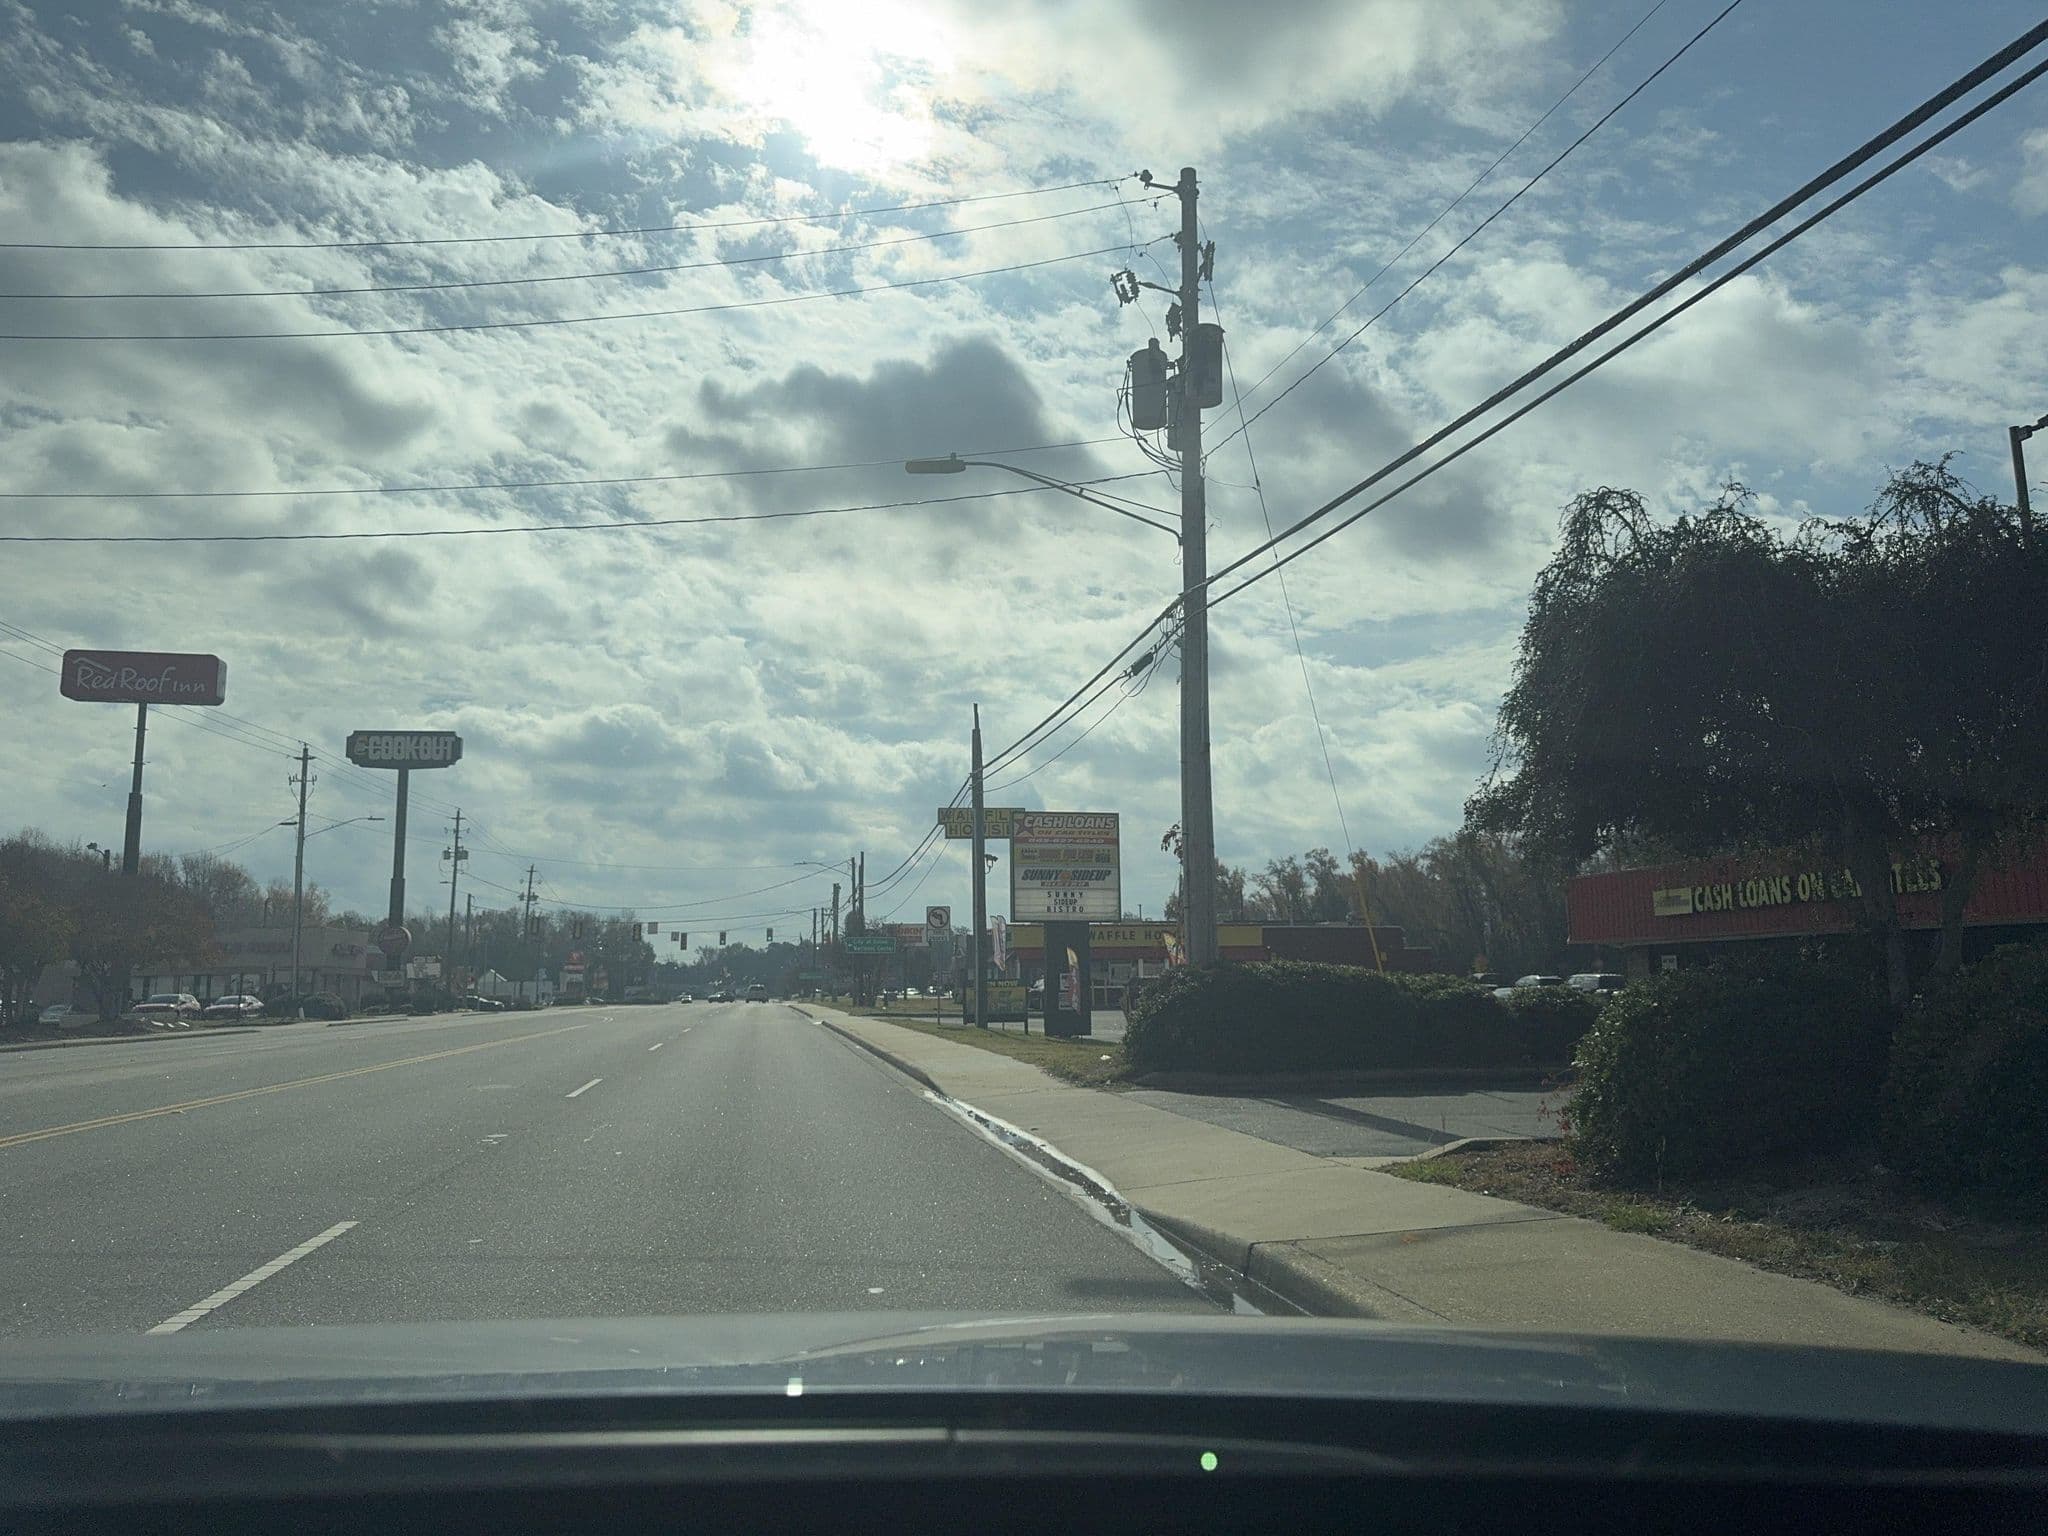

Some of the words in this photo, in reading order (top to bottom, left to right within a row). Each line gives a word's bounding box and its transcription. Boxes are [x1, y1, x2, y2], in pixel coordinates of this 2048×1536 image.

[76, 665, 118, 690] Red
[120, 667, 176, 693] Roof
[1023, 816, 1063, 828] CASH
[1066, 816, 1116, 829] LOANS
[1022, 868, 1061, 881] SUNNY
[1694, 883, 1733, 913] CASH
[1738, 876, 1791, 908] LOANS
